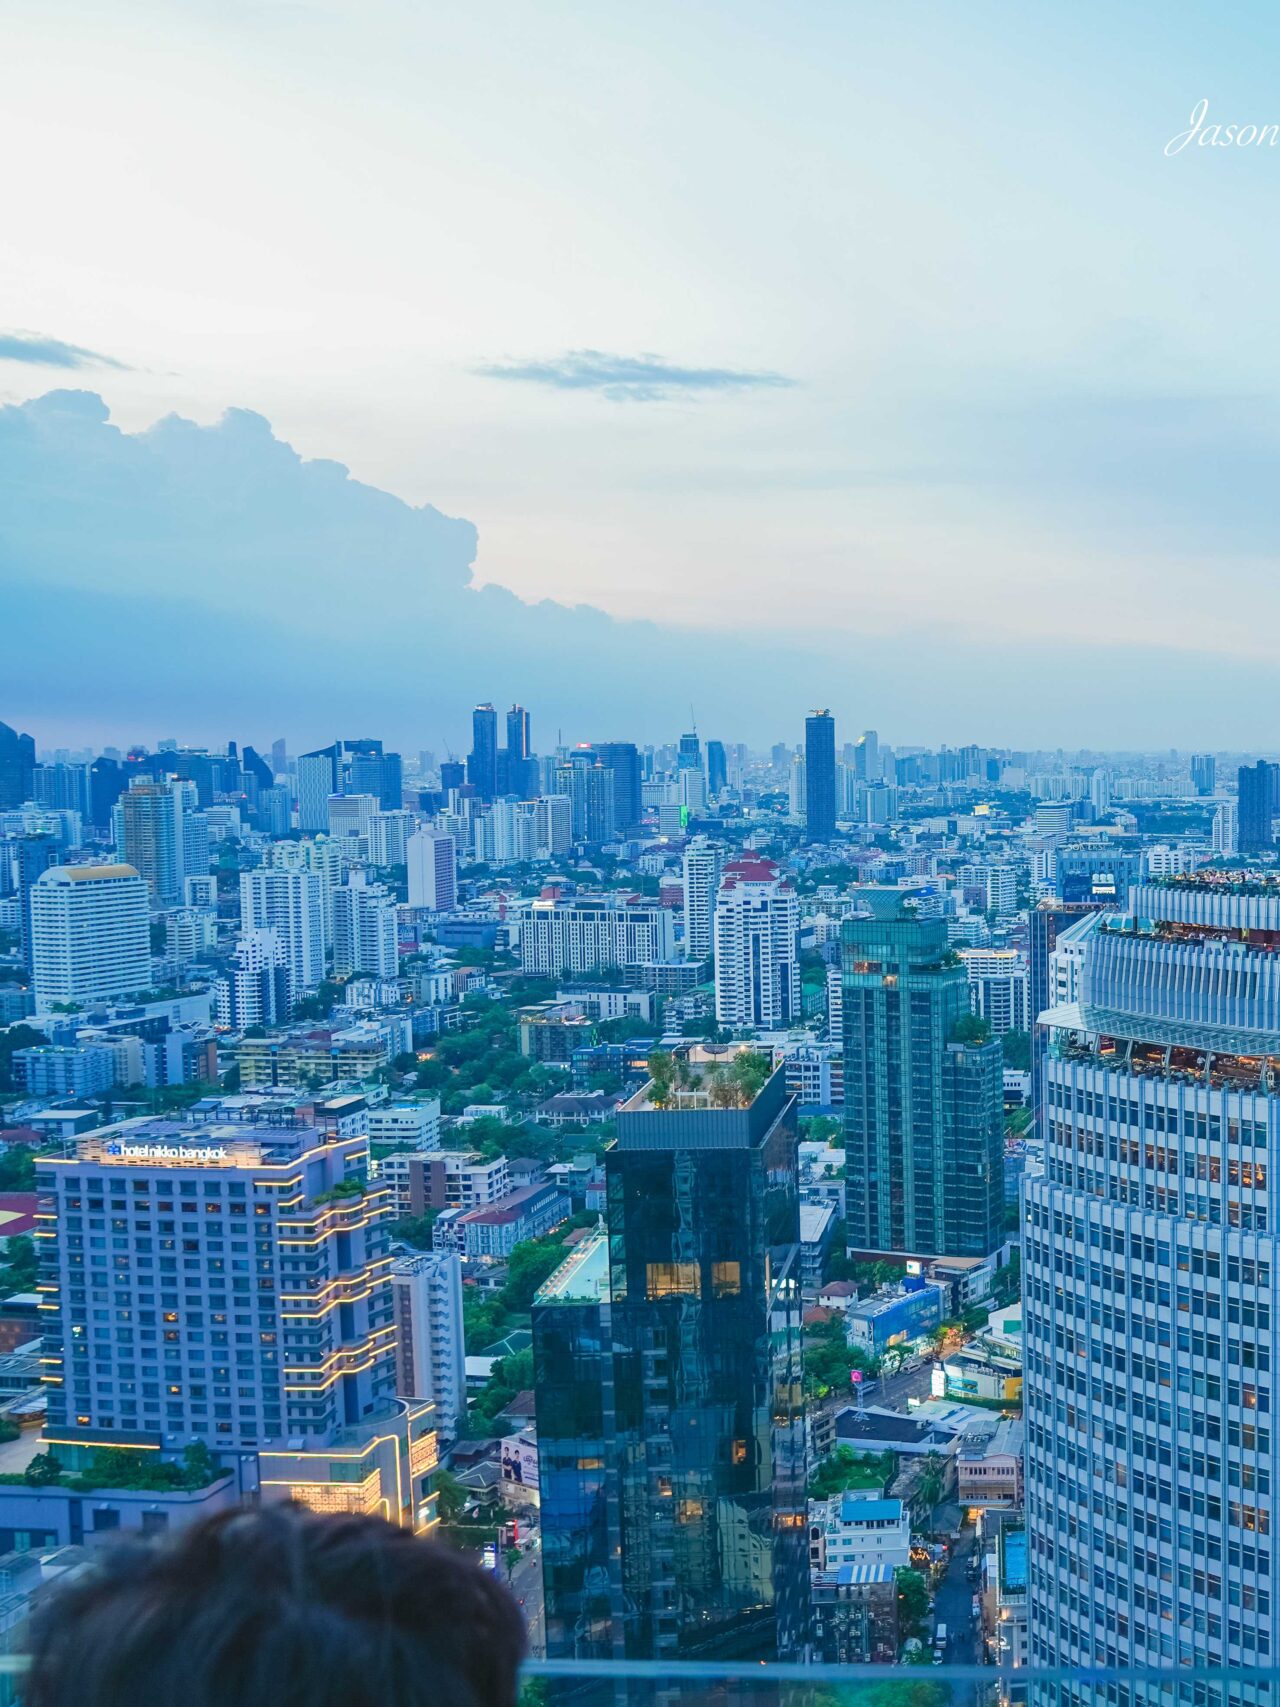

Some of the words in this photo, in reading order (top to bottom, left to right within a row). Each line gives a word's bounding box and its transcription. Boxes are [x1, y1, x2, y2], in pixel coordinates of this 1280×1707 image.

[120, 1144, 149, 1157] hotel
[149, 1145, 178, 1158] nikko
[180, 1146, 228, 1161] bangkok
